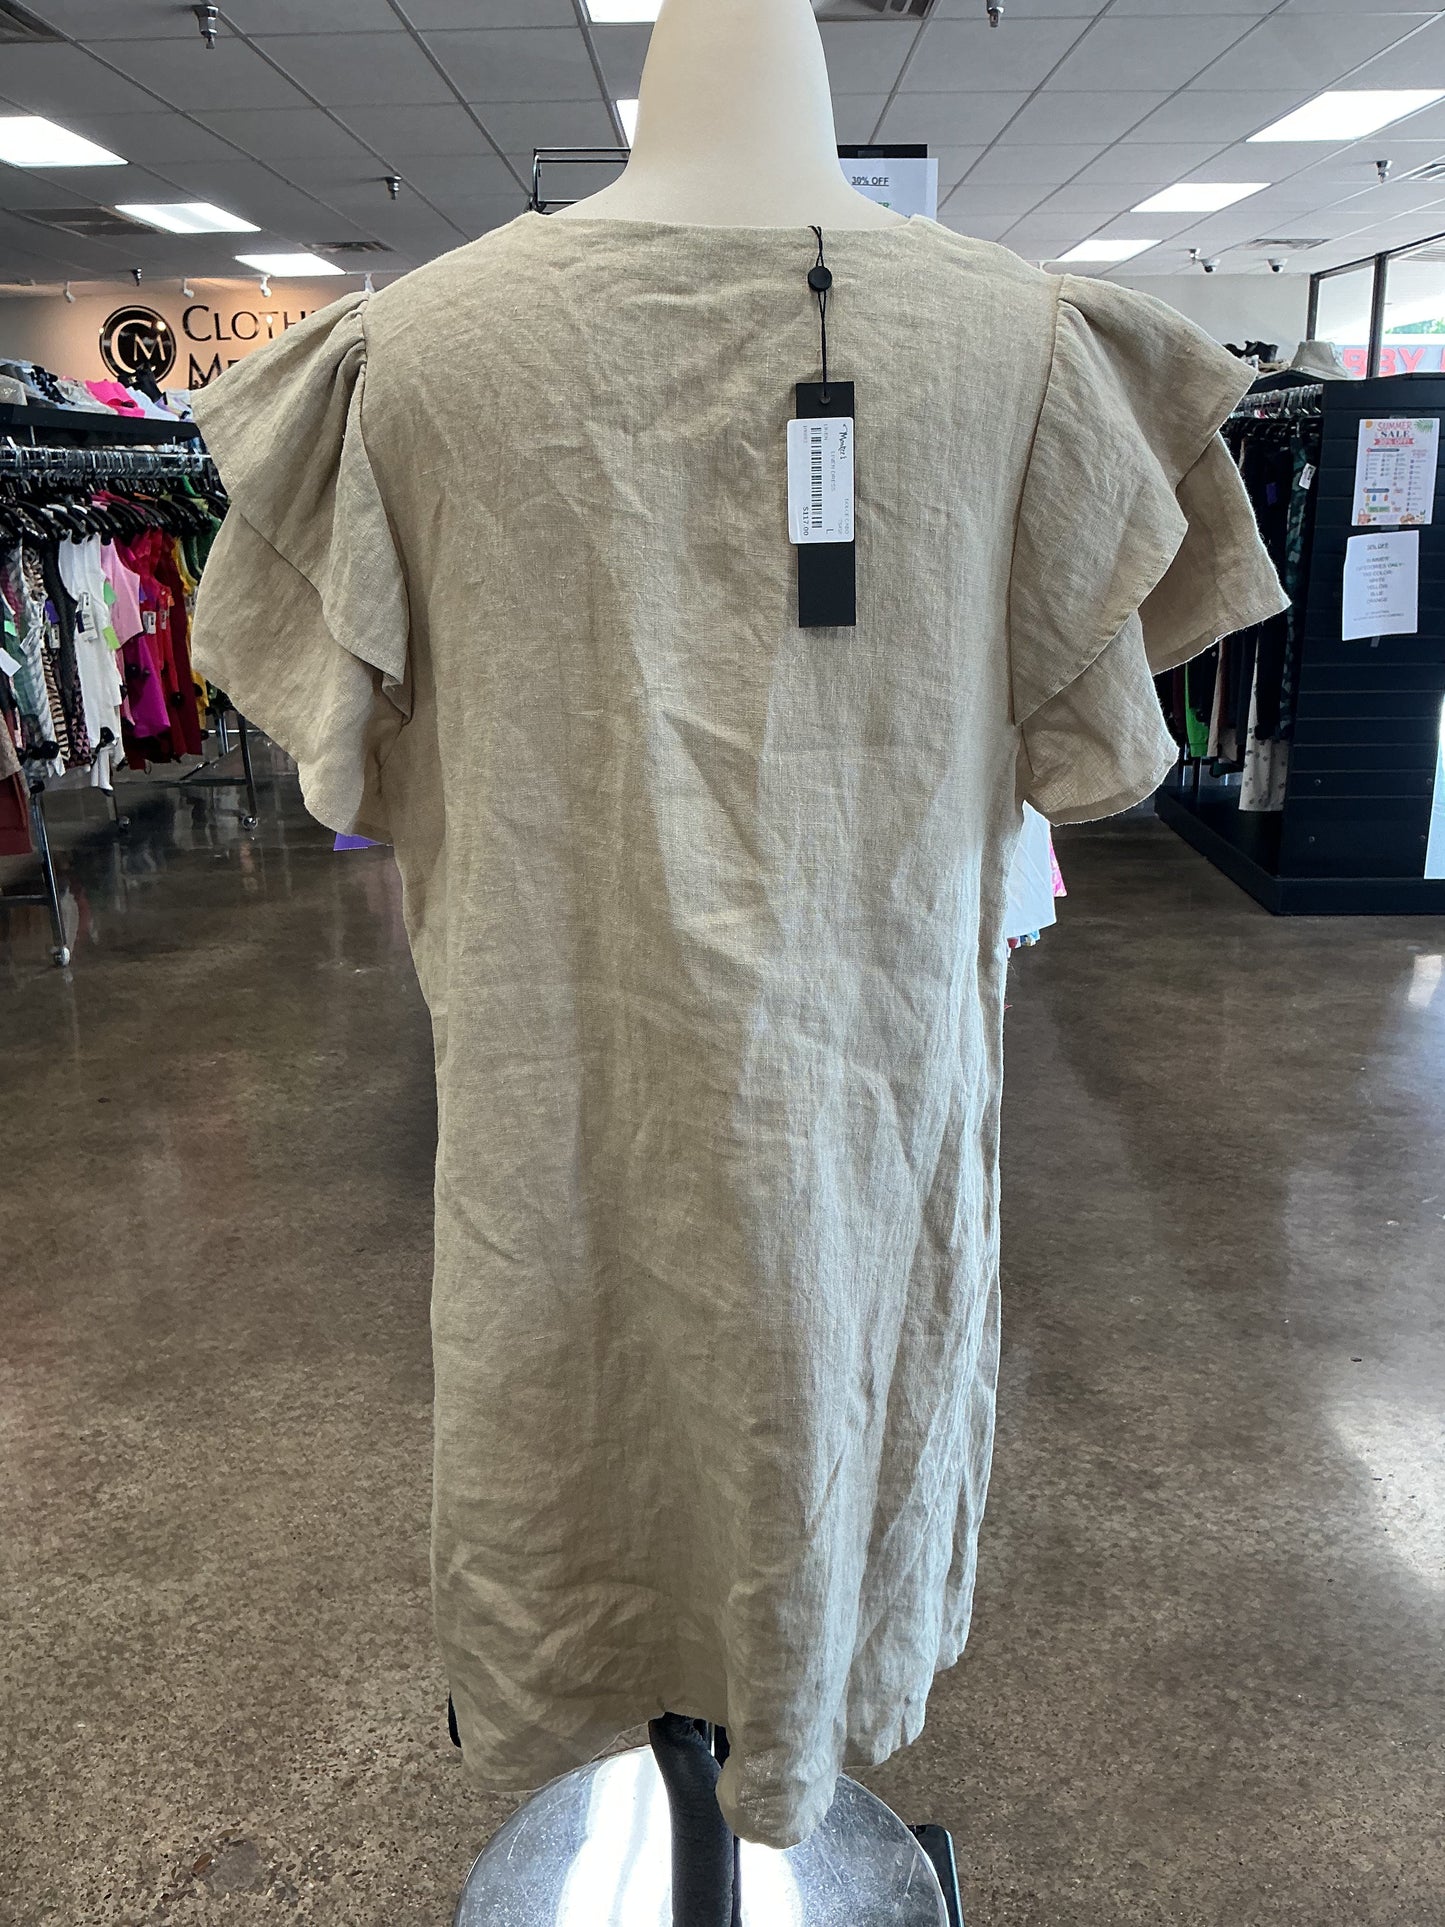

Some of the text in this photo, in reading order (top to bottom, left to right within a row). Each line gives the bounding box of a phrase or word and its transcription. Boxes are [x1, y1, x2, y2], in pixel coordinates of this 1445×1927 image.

[851, 176, 889, 185] 30% OFF
[1377, 421, 1412, 431] SUMMER
[1380, 430, 1410, 438] SALE
